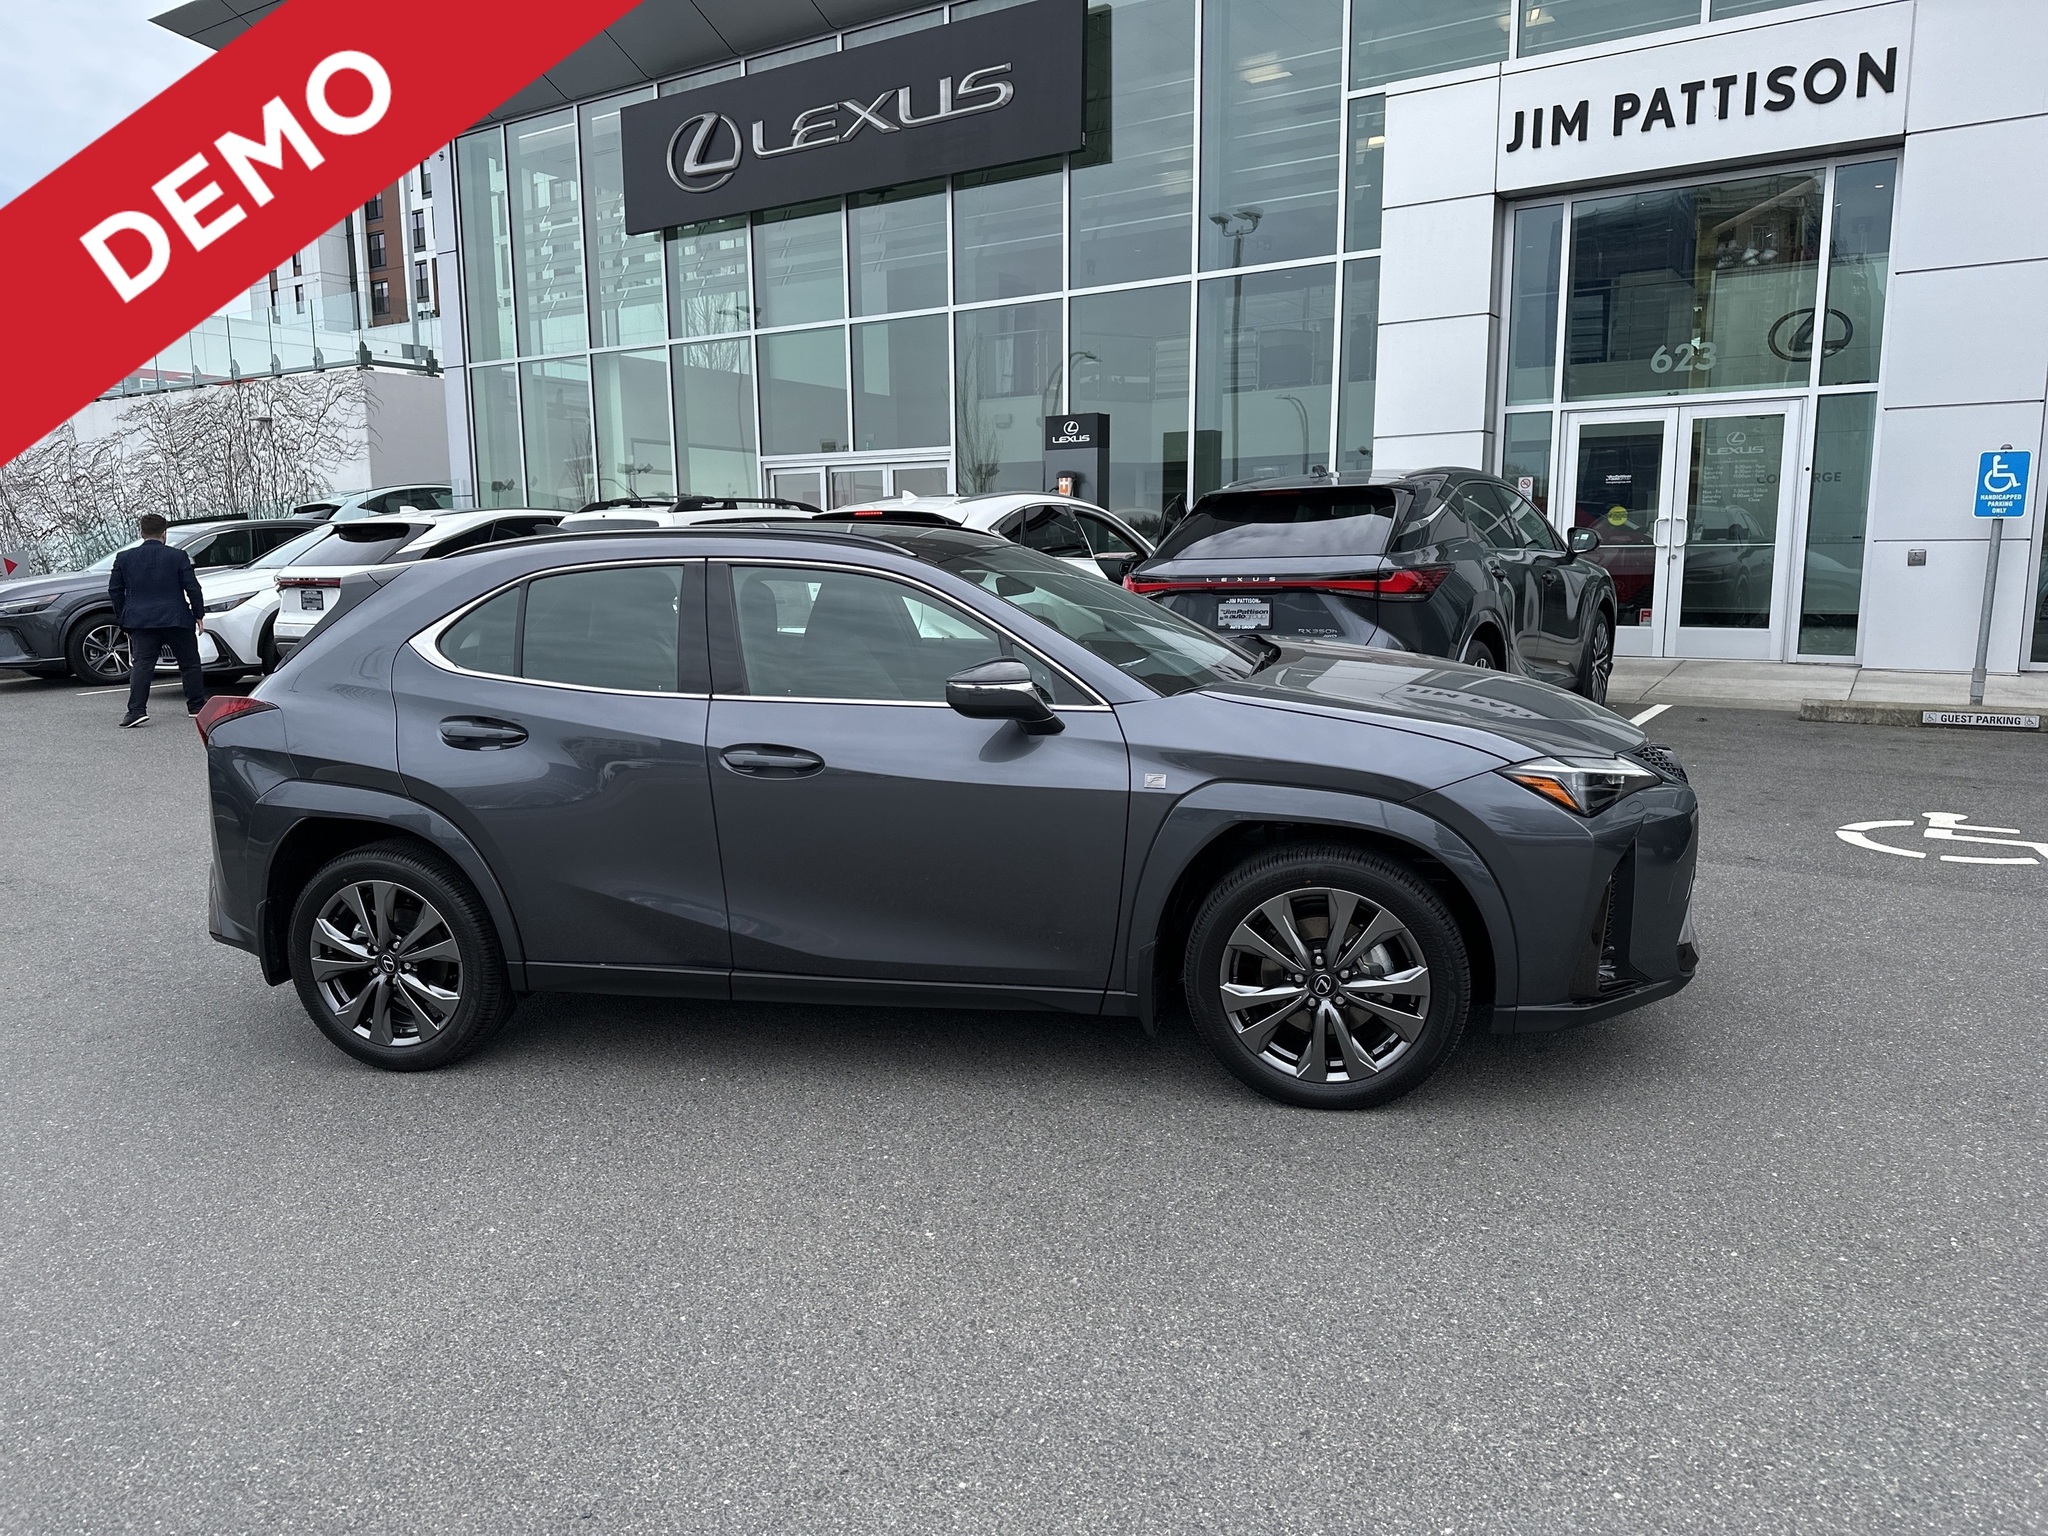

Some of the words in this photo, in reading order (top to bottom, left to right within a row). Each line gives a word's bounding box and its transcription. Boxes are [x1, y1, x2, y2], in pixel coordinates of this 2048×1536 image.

[752, 62, 1014, 160] LEXUS
[1506, 100, 1589, 153] JIM
[1613, 47, 1898, 137] PATTISON
[1650, 341, 1718, 374] 623
[1052, 434, 1090, 444] LEXUS
[1706, 445, 1765, 456] LEXUS
[1940, 714, 1973, 724] GUEST
[1976, 715, 2021, 726] PARKING
